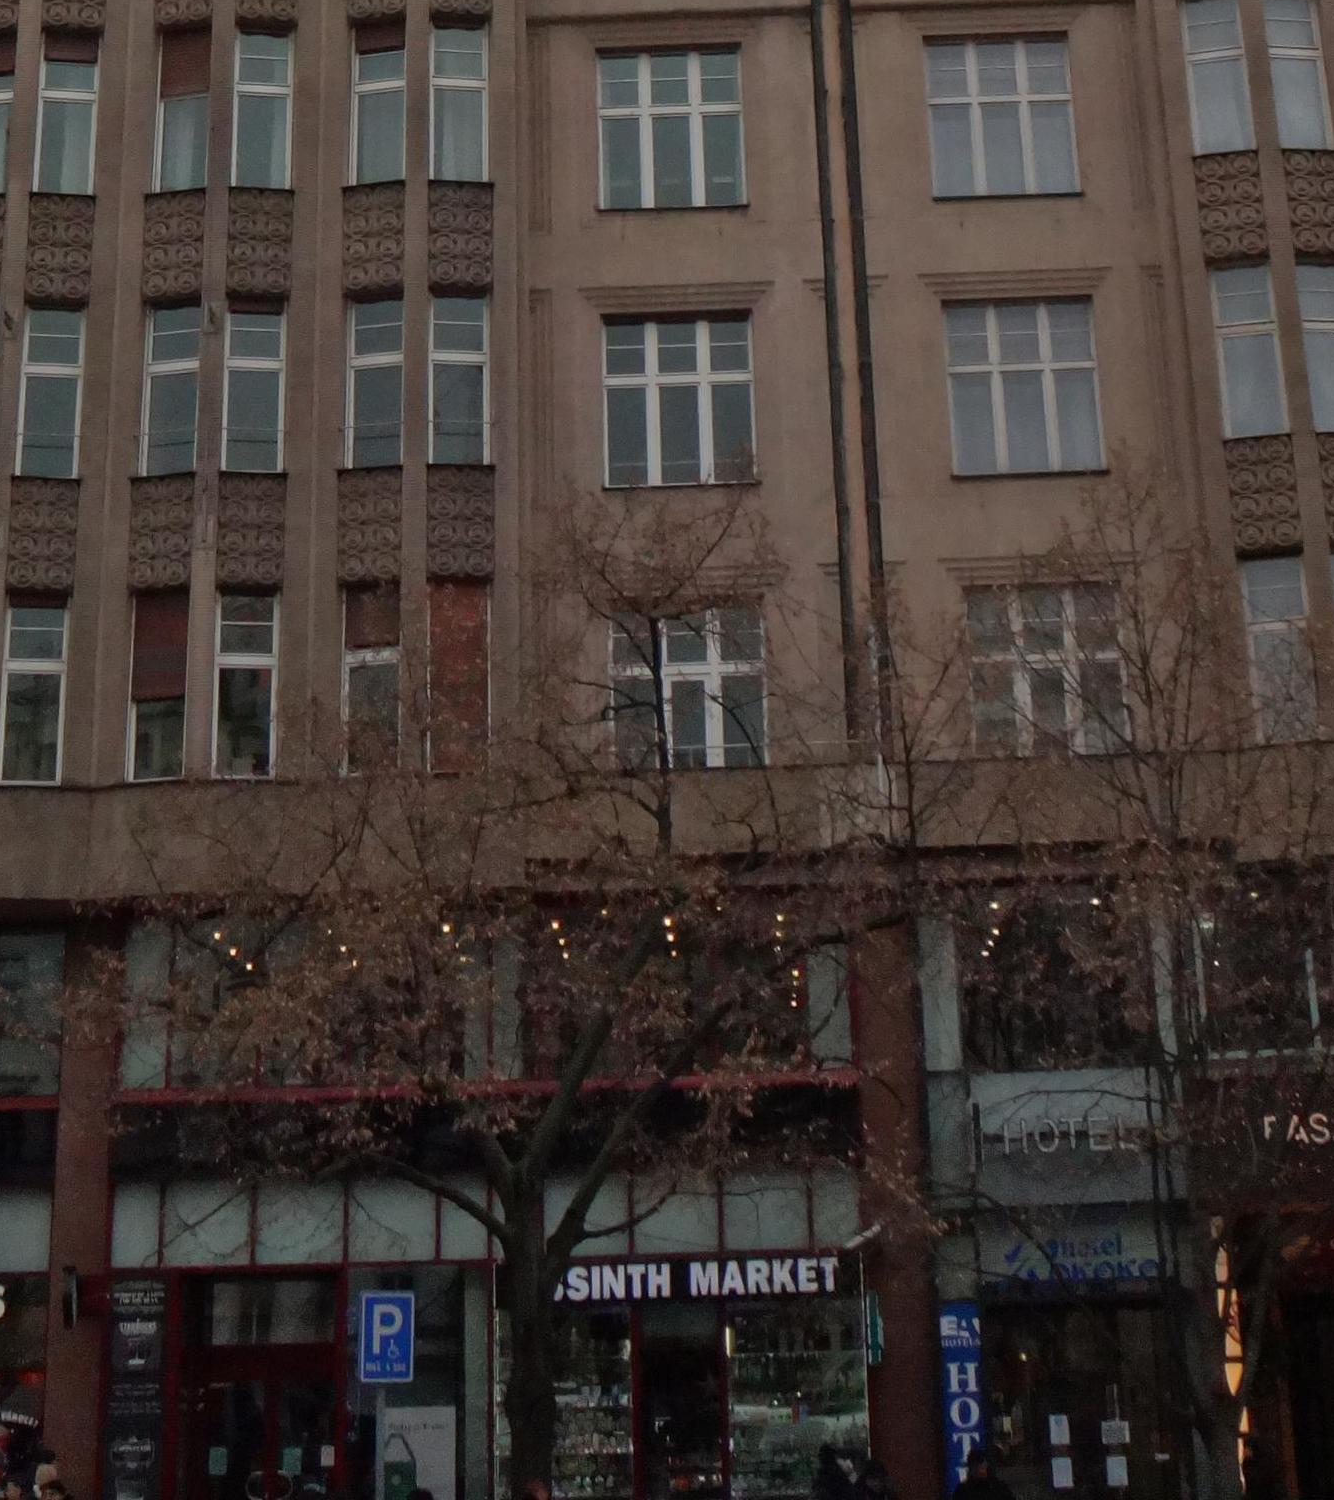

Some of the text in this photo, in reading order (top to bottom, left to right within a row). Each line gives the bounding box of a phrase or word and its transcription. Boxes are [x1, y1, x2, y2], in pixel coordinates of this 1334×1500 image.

[1003, 1115, 1137, 1155] HOTEL
[554, 1257, 838, 1301] SINTH MARKET
[373, 1304, 403, 1354] P
